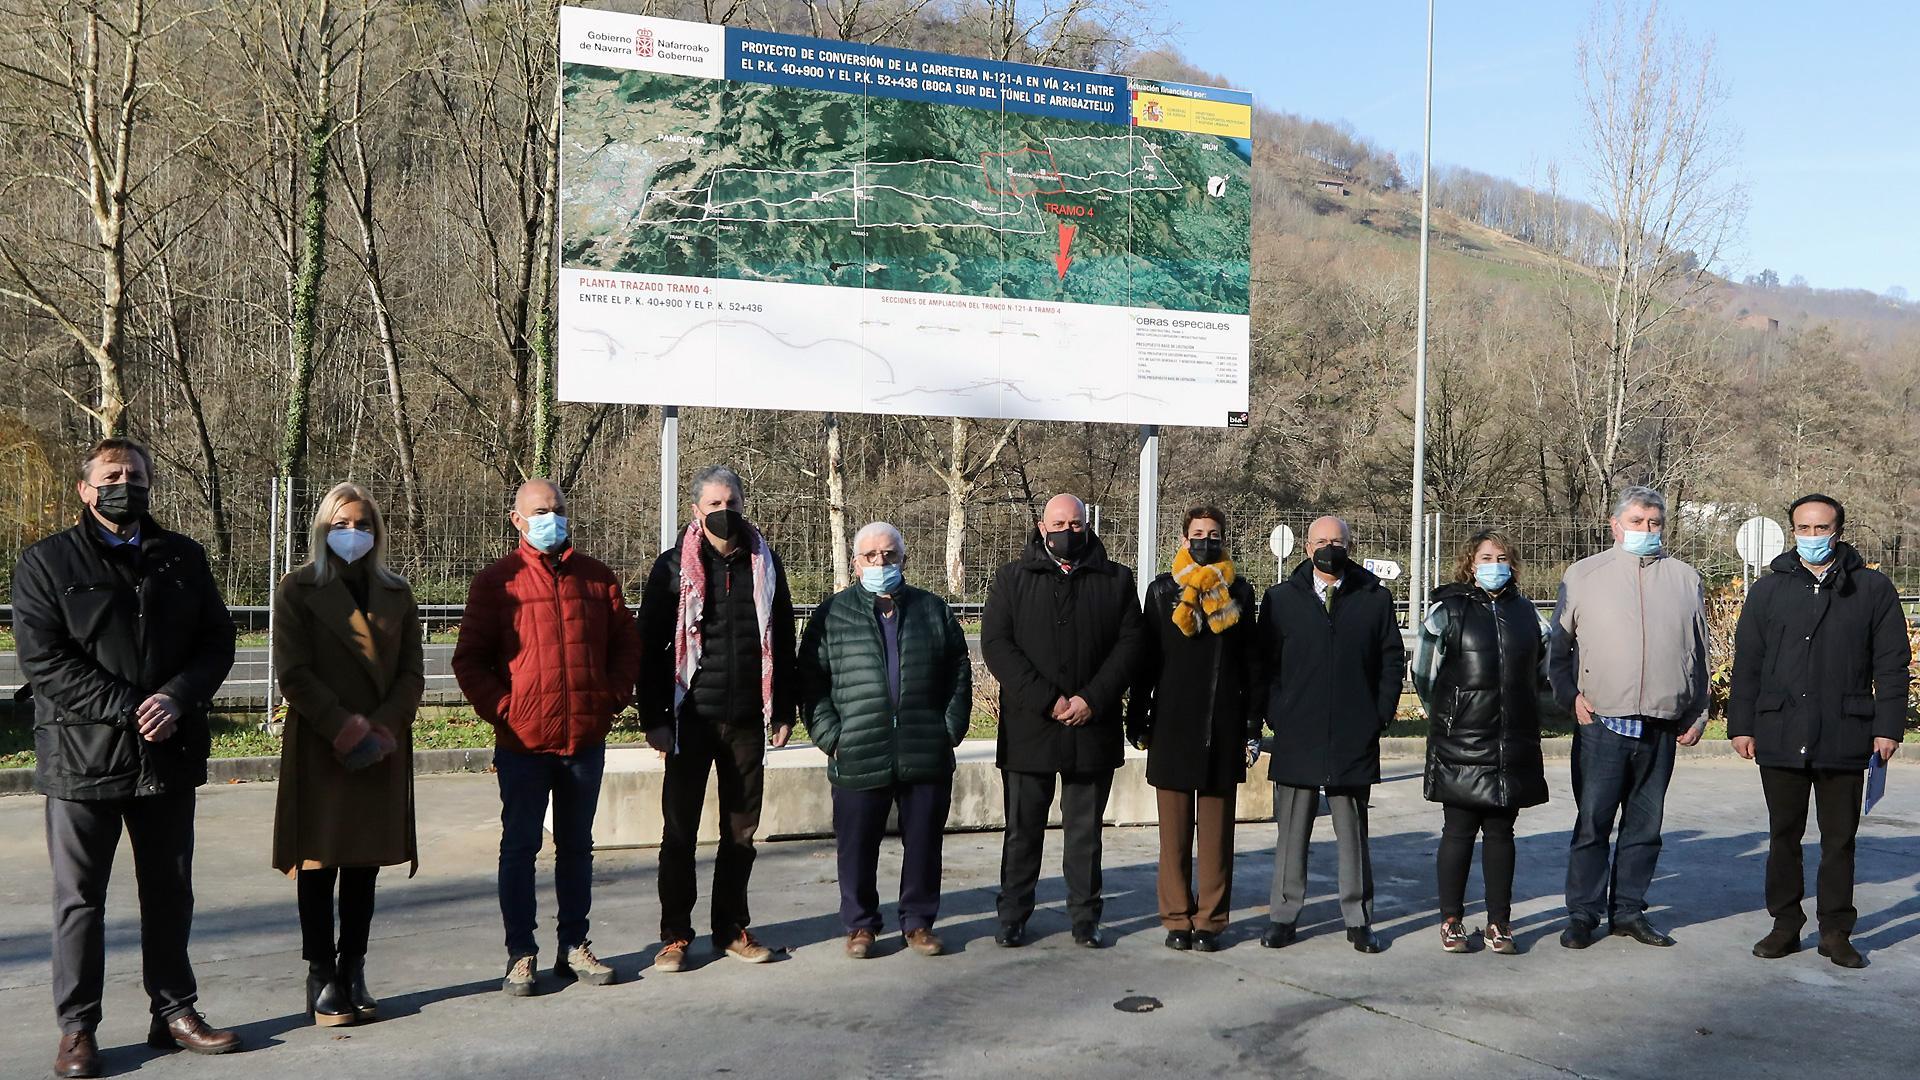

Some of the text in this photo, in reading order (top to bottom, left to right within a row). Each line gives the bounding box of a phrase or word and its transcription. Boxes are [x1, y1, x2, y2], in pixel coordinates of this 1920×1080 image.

[588, 31, 632, 44] Gobierno
[579, 41, 632, 55] de Navarra
[657, 39, 710, 53] Nafarroako
[657, 50, 704, 63] Gobernua
[741, 41, 1115, 97] PROYECTO DE CONVERSIÓN DE LA CARRETERA N-121-A EN VÍA 2+1 ENTRE
[741, 58, 1115, 114] EL P.K. 40+900 Y EL P.K. 52+436 (BOCA SUR DEL TÚNEL DE ARRIGAZTELU)
[1161, 86, 1193, 98] financiada
[1194, 90, 1207, 99] por:
[657, 133, 706, 146] PAMPLONA
[1044, 202, 1094, 217] TRAMO 4
[579, 277, 617, 290] PLANTA
[621, 280, 664, 292] TRAZADO
[667, 282, 700, 295] TRAMO
[579, 293, 608, 304] ENTRE
[611, 295, 622, 304] EL
[624, 296, 631, 305] P.
[635, 297, 644, 306] K.
[647, 298, 683, 308] 40+900
[685, 299, 691, 308] Y
[694, 300, 704, 309] EL
[729, 302, 763, 313] 52+436
[881, 295, 917, 305] SECCIONES
[918, 298, 927, 306] DE
[928, 298, 967, 309] AMPLIACIÓN
[968, 301, 980, 309] DEL
[981, 302, 1006, 311] TRONCO
[1034, 305, 1056, 314] TRAMO
[1056, 307, 1061, 315] 4
